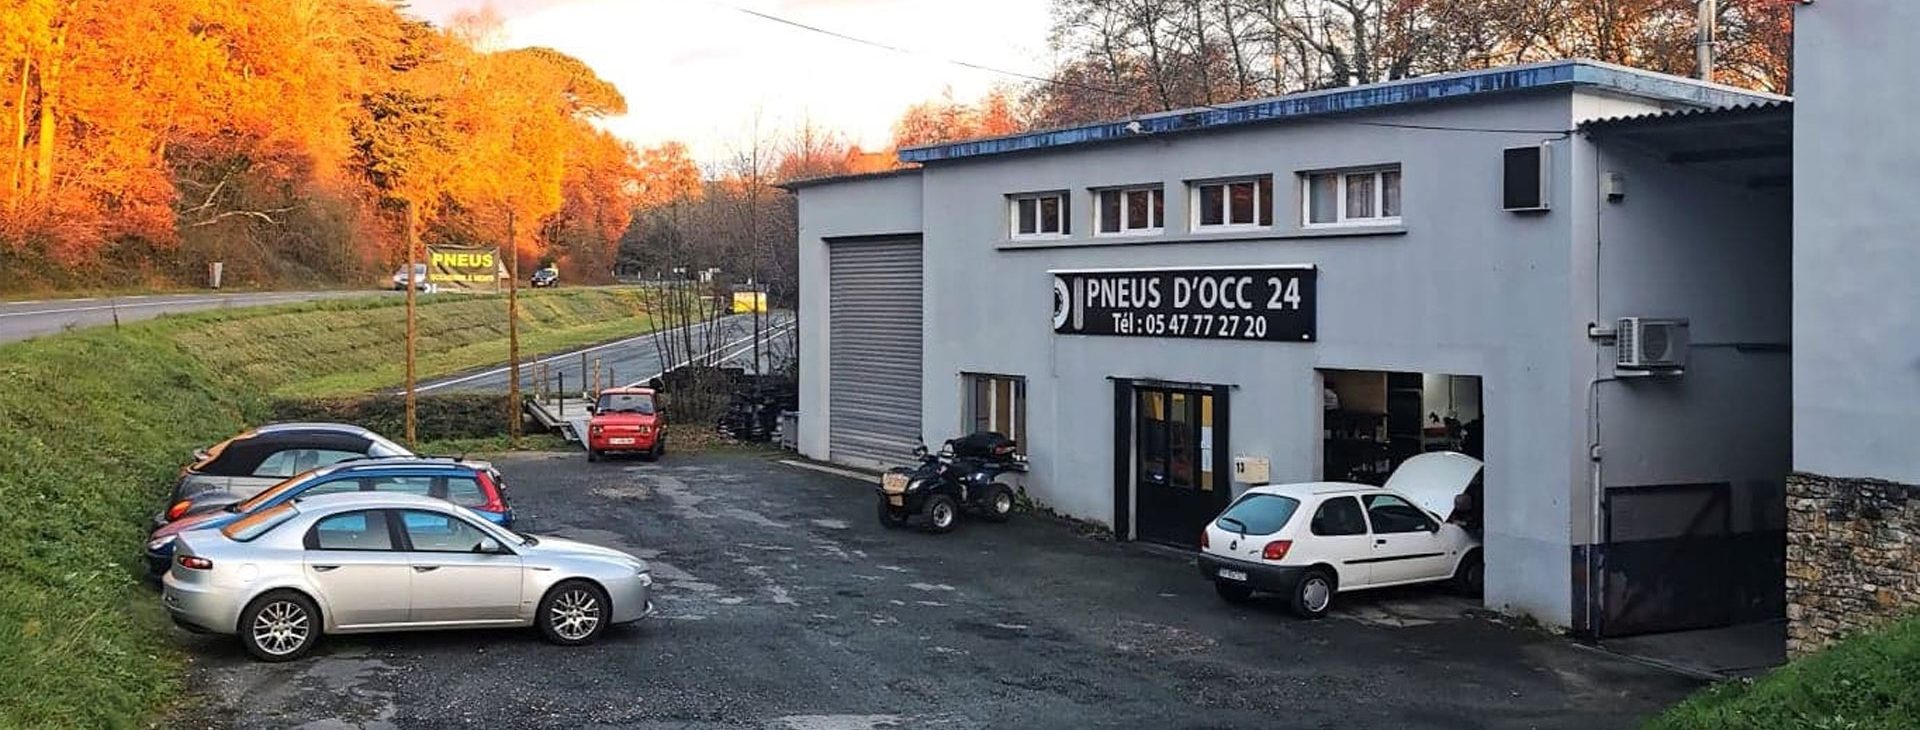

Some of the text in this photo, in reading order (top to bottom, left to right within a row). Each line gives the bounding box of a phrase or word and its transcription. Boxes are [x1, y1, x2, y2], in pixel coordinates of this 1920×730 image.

[432, 252, 493, 268] PNEUS
[1087, 276, 1300, 310] PNEUS D'OCC 24
[1112, 311, 1134, 334] Tél
[1146, 313, 1165, 335] 05
[1168, 314, 1189, 335] 47
[1193, 314, 1213, 336] 77
[1218, 315, 1240, 337] 27
[1244, 315, 1267, 338] 20
[1236, 461, 1244, 474] 13
